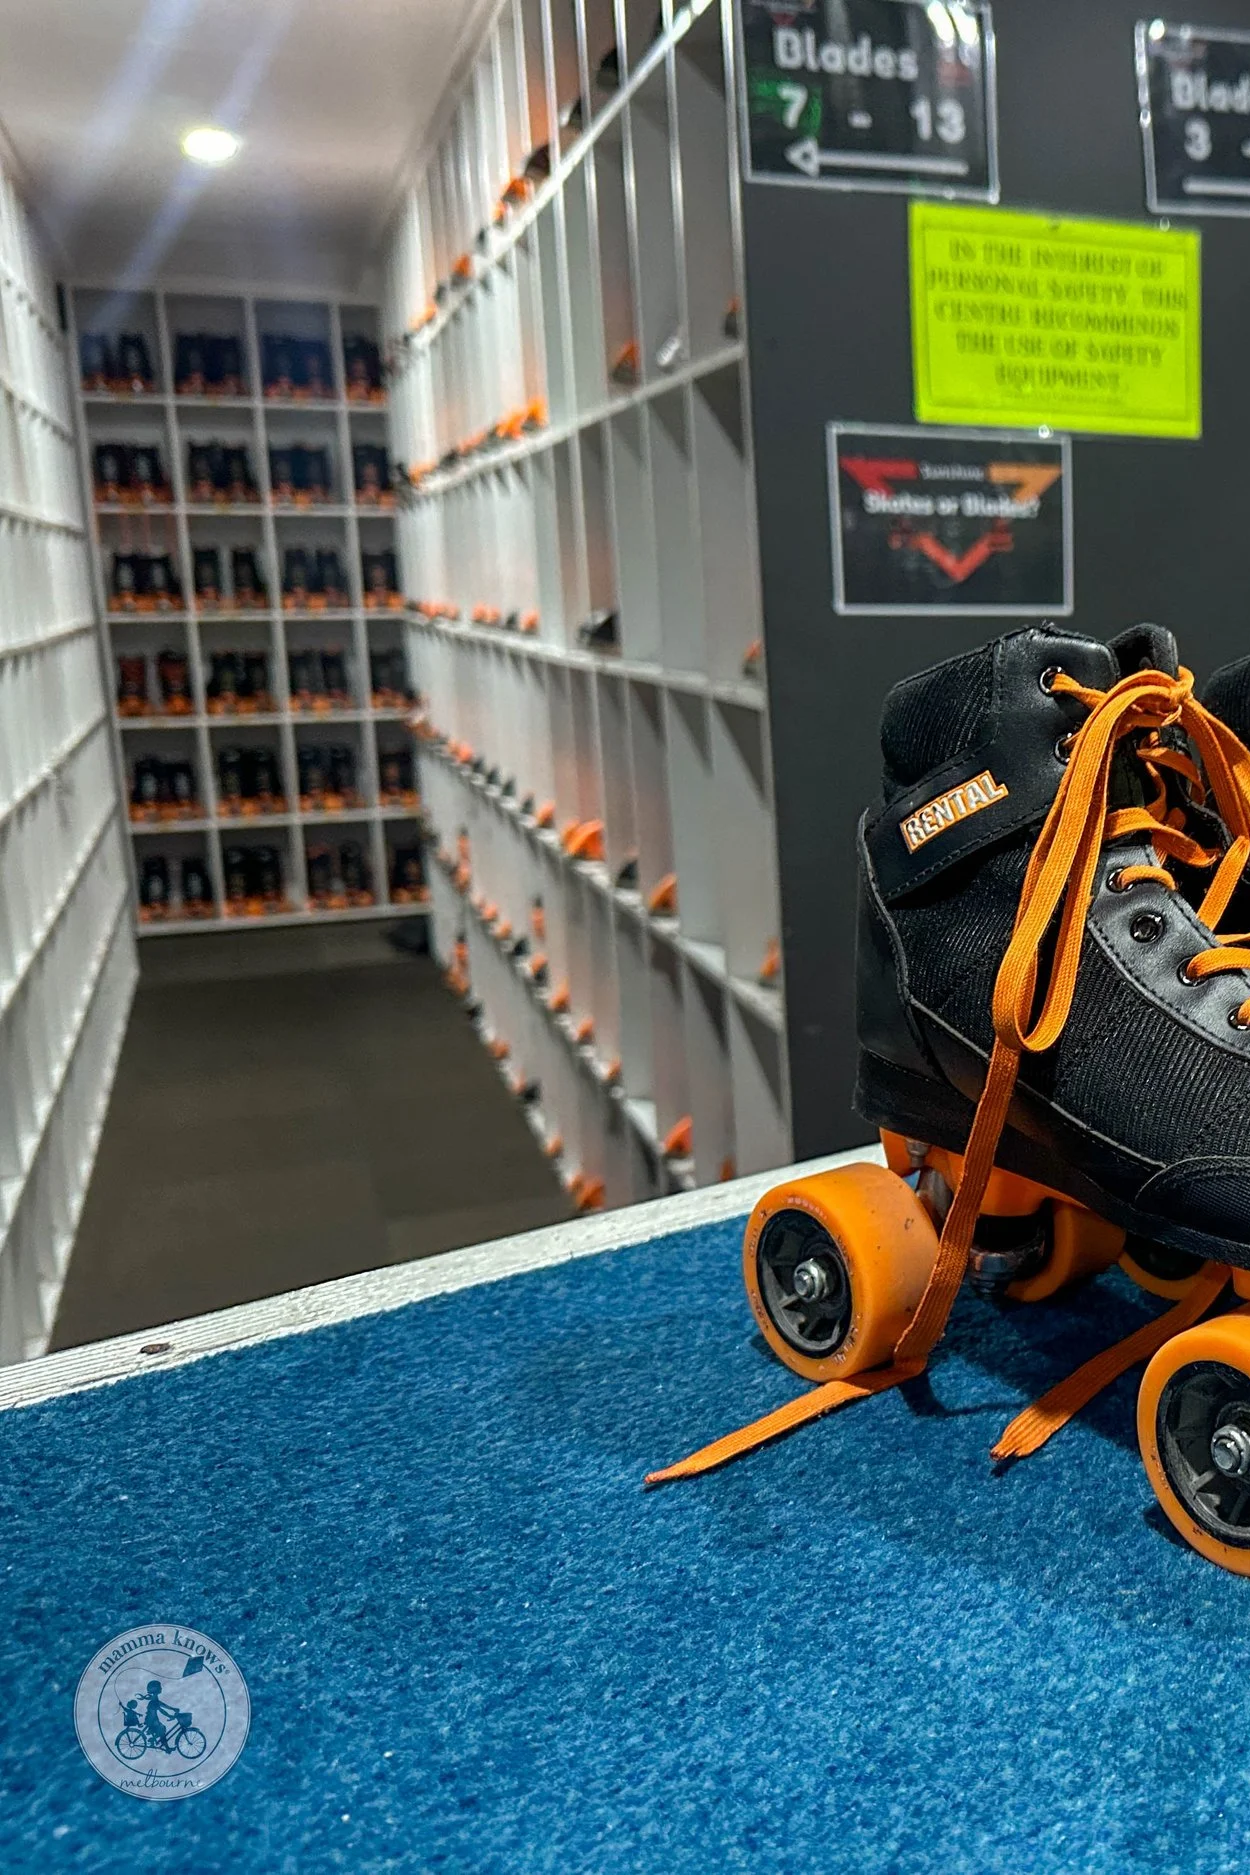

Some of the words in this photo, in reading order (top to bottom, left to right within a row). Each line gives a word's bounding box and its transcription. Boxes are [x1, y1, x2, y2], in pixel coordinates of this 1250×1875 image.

[774, 26, 919, 81] Blades
[776, 82, 808, 129] 7
[909, 96, 966, 144] 13
[1184, 118, 1212, 161] 3
[949, 237, 976, 262] IN
[983, 240, 1022, 266] THE
[928, 268, 1039, 298] PERSONAL
[934, 299, 1021, 323] CENTRE
[956, 329, 995, 355] THE
[1003, 333, 1042, 358] USE
[1049, 337, 1078, 360] OF
[935, 495, 959, 516] or
[905, 774, 1004, 846] RENTAL
